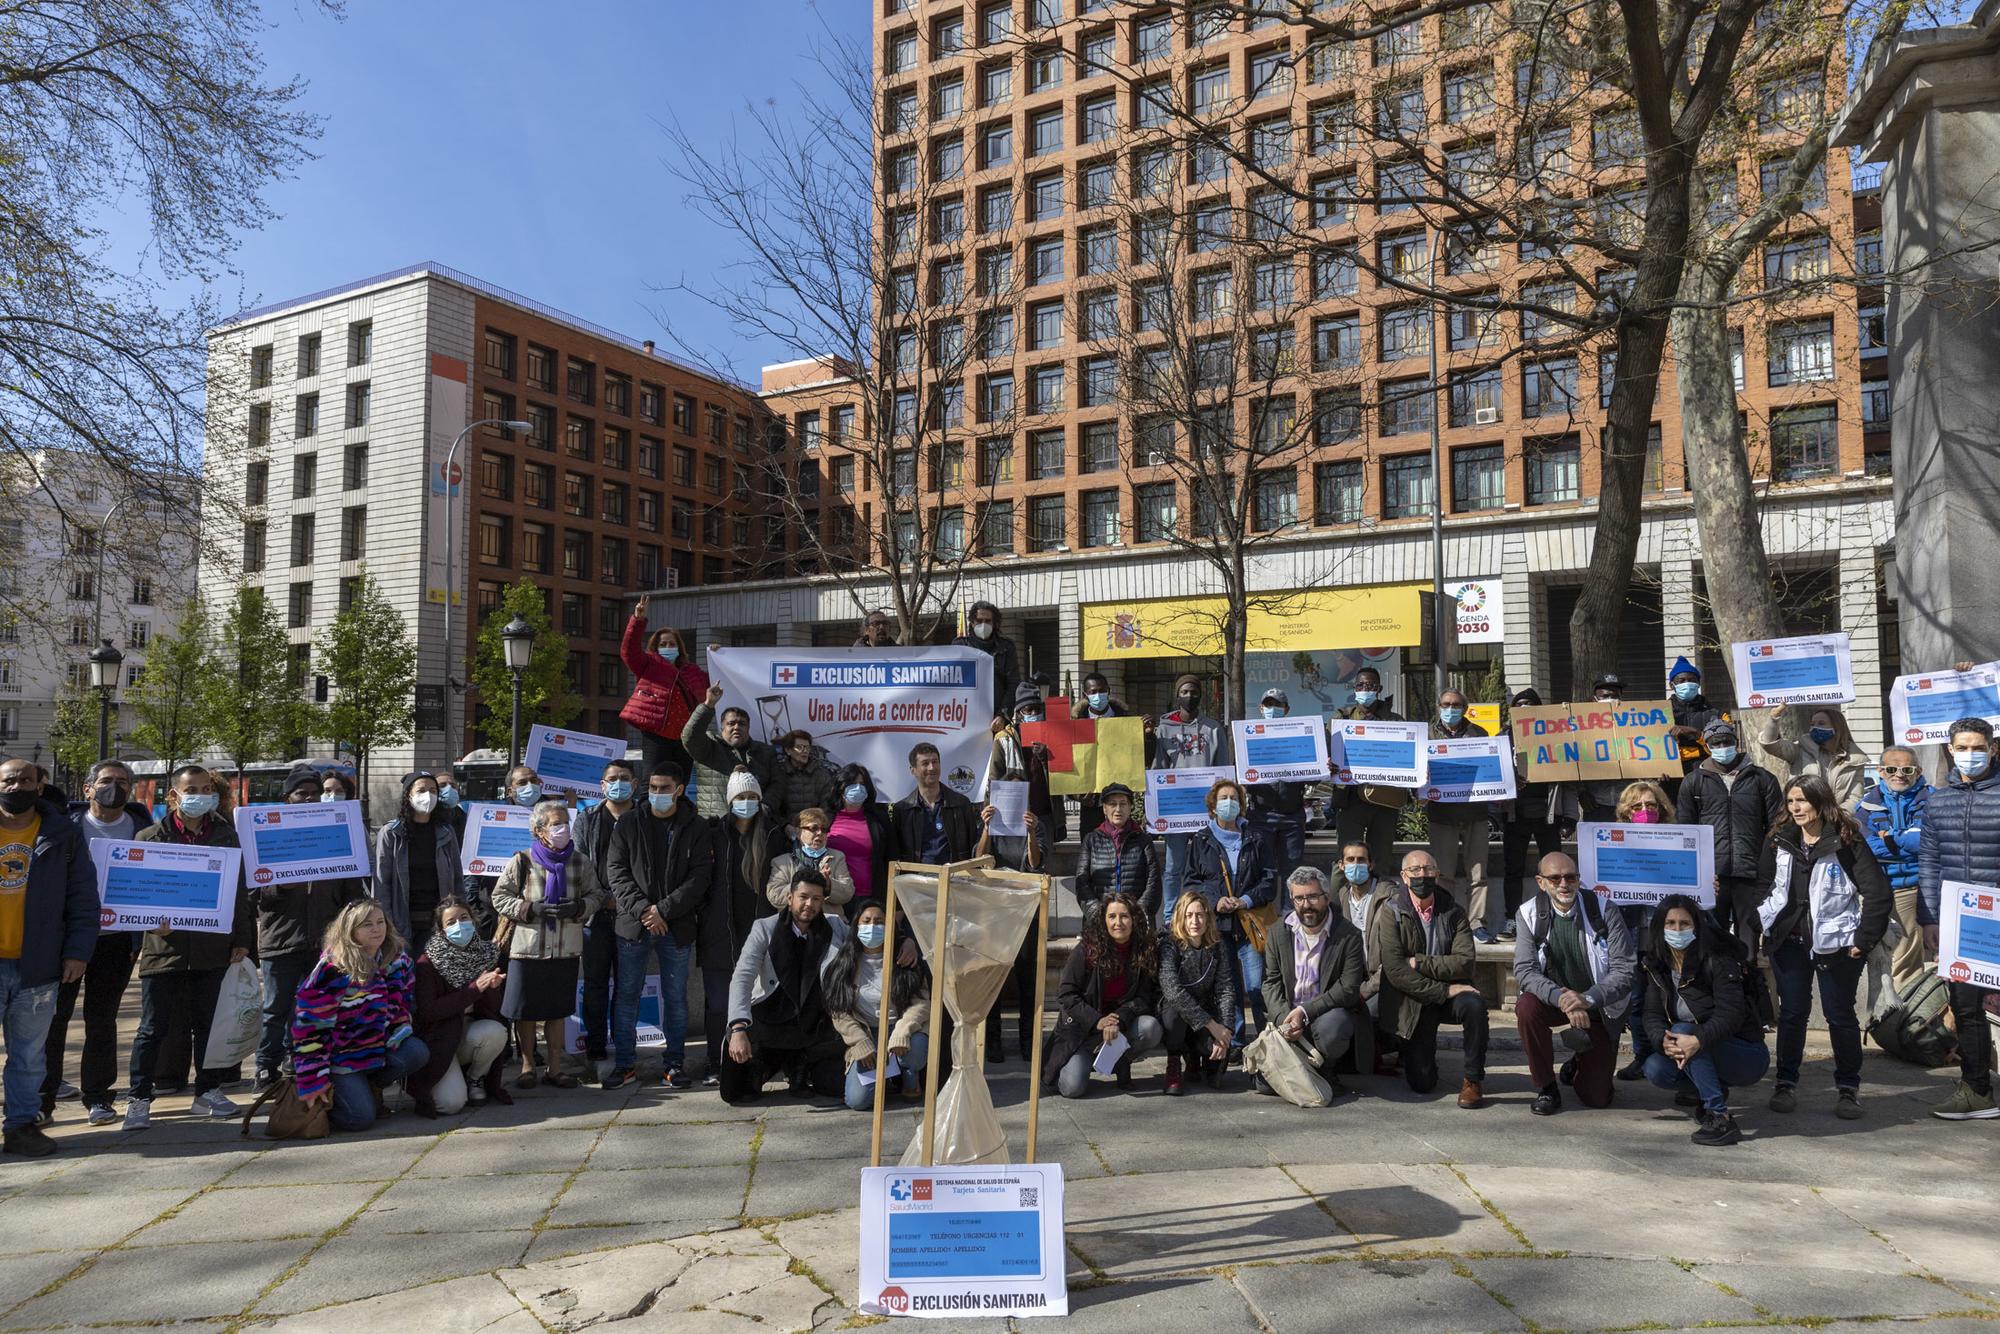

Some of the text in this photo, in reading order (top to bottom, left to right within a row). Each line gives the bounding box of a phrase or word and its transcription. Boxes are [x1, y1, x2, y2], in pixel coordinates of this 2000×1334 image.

[1456, 623, 1489, 633] 2030
[811, 664, 963, 684] EXCLUSIÓN SANITARIA
[1246, 670, 1290, 682] ALUD
[1807, 692, 1844, 702] SANITARIA
[808, 698, 968, 728] Una lucha a contra reloj
[1260, 770, 1291, 778] EXCLUSIÓN
[1292, 769, 1321, 777] SANITARIA
[1354, 773, 1386, 781] EXCLUSIÓN
[1443, 789, 1475, 798] EXCLUSIÓN
[1476, 788, 1507, 796] SANITARIA
[1170, 820, 1199, 828] EXCLUSIÓN
[276, 867, 318, 879] EXCLUSIÓN
[320, 864, 358, 874] SANITARIA
[1613, 891, 1658, 901] EXCLUSIÓN
[100, 914, 116, 922] TOP
[172, 918, 219, 927] SANITARIA
[1950, 967, 1970, 978] STOP
[953, 1187, 975, 1195] Tarjeta
[880, 1291, 1047, 1310] STOP EXCLUSIÓN SANITARIA
